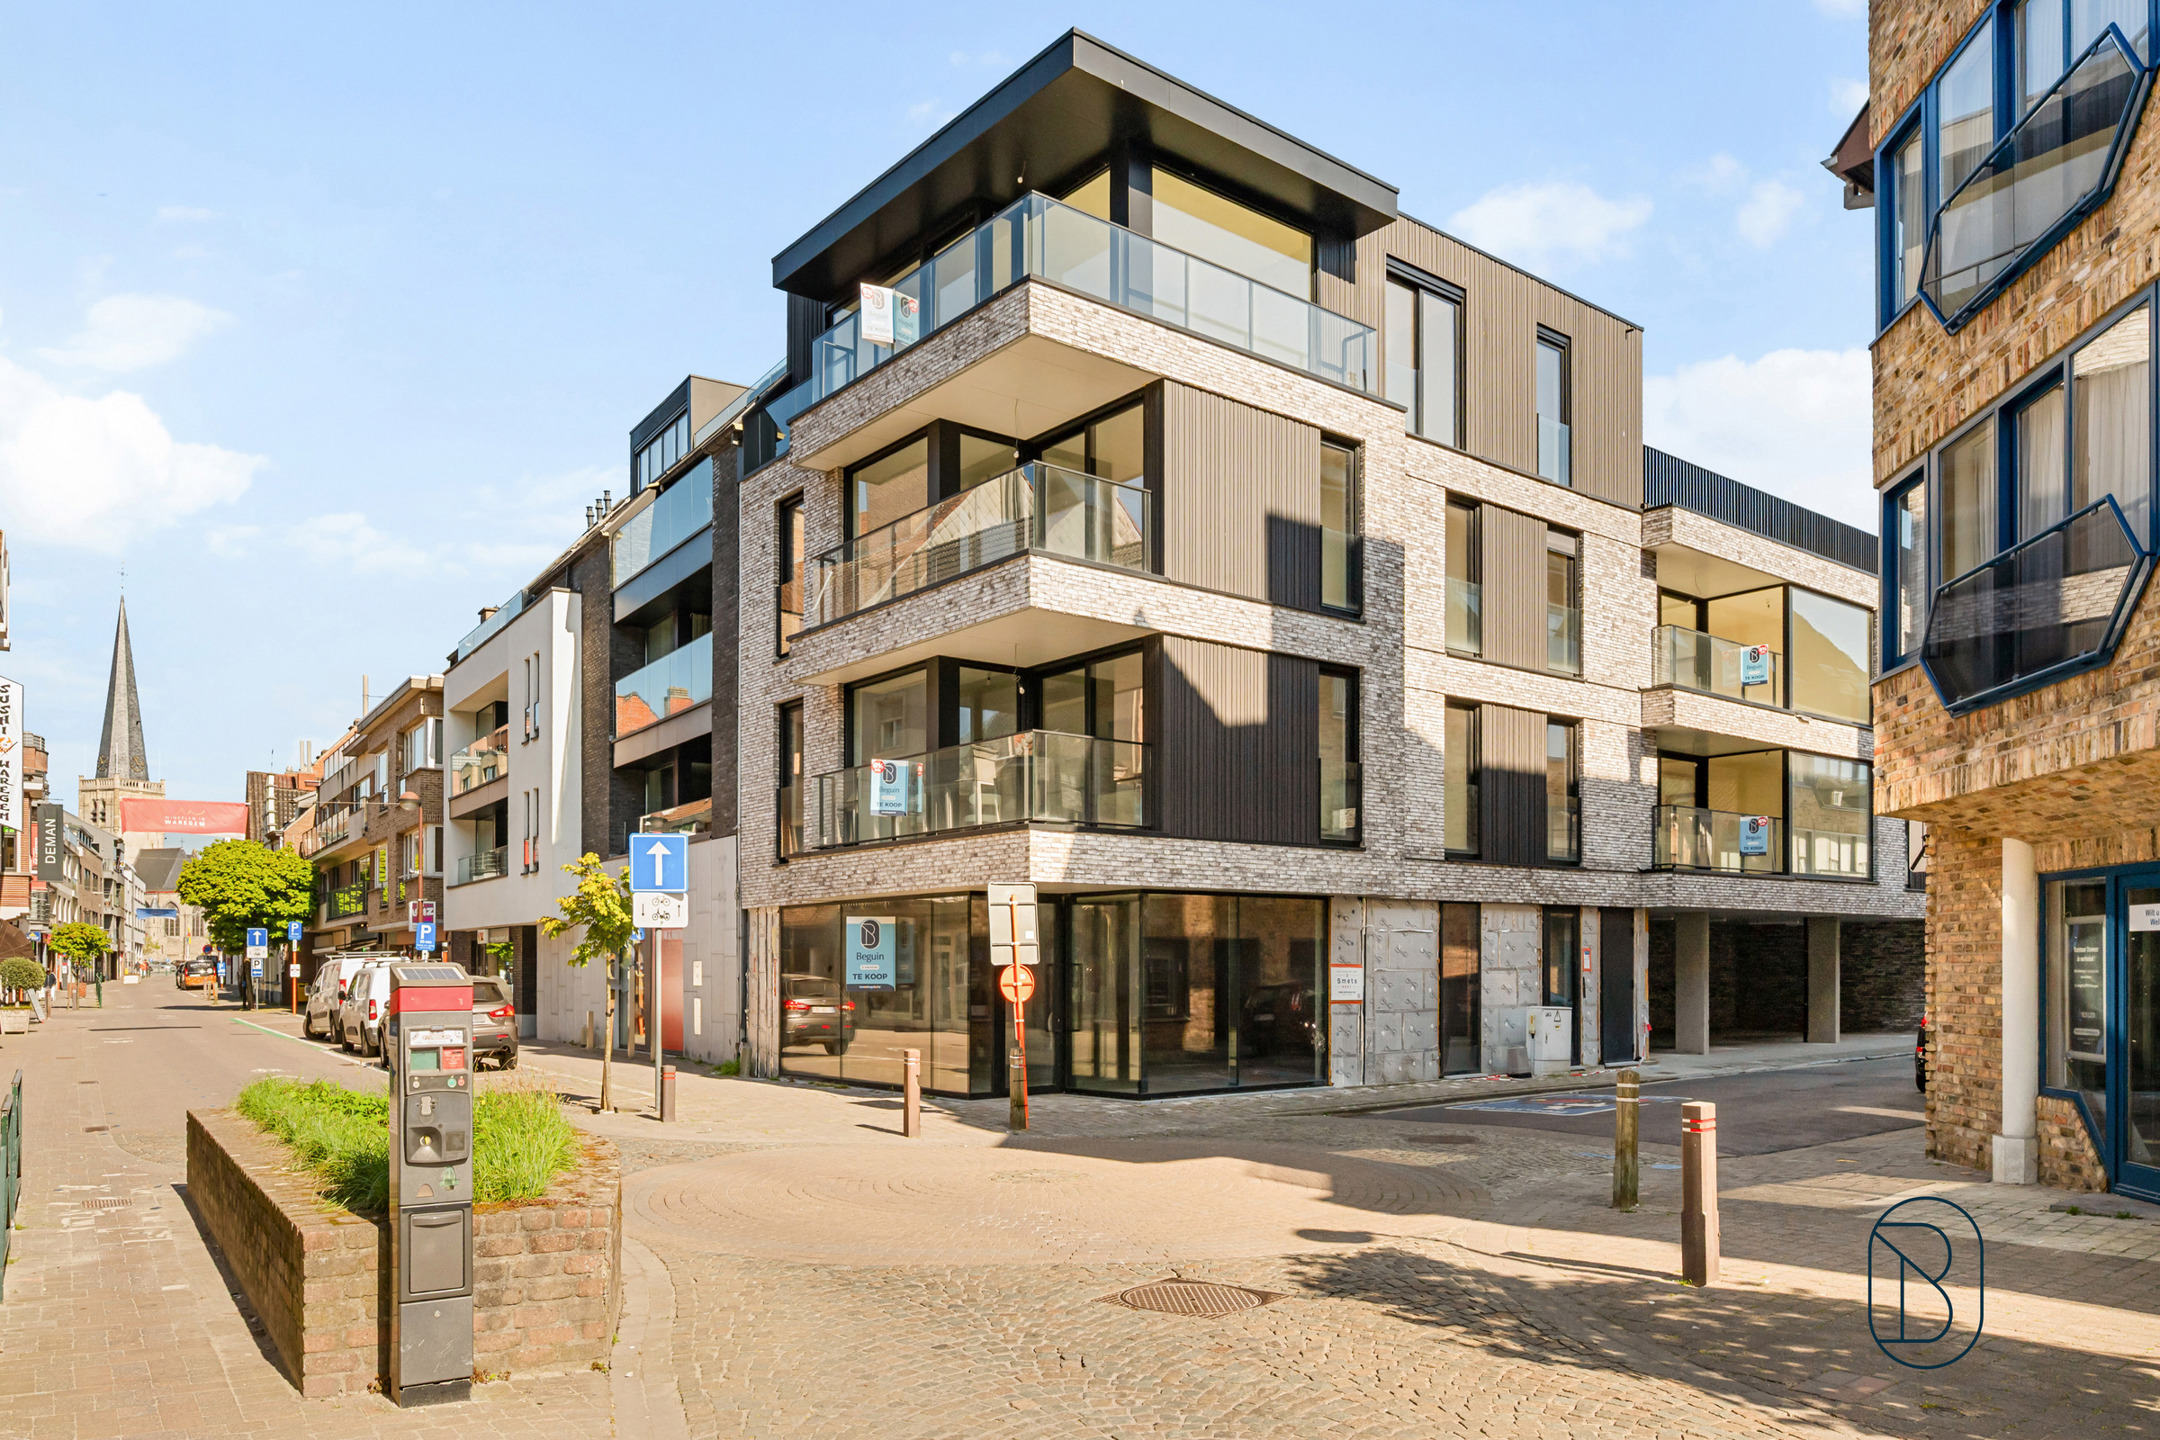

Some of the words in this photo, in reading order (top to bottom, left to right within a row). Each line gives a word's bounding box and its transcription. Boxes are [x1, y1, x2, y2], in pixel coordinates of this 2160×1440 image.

[164, 819, 206, 827] WAREGEM
[45, 818, 56, 864] DEMAN
[291, 922, 299, 934] P
[420, 924, 432, 940] P
[856, 951, 885, 963] Beguin
